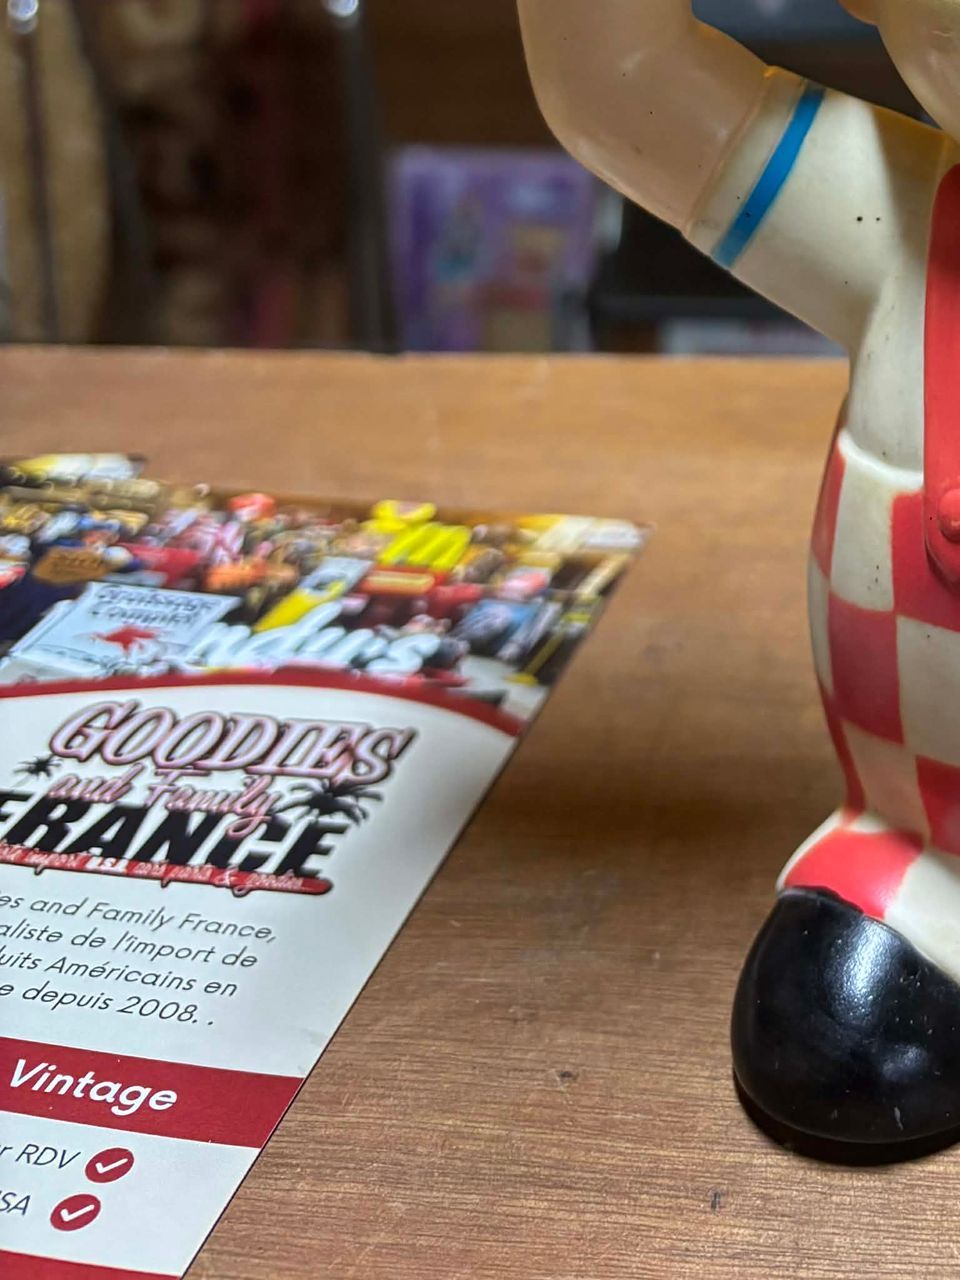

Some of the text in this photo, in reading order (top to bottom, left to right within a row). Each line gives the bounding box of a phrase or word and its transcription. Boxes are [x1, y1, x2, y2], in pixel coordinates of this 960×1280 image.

[50, 699, 417, 786] GOODIES
[48, 763, 283, 841] and Family
[30, 897, 89, 916] and
[87, 902, 175, 931] Family
[178, 913, 277, 944] France,
[70, 927, 106, 949] de
[112, 931, 216, 963] l'import
[221, 945, 258, 969] de
[22, 981, 113, 1011] depuis
[44, 956, 197, 992] Américains
[203, 980, 238, 998] en
[9, 1058, 177, 1116] Vintage
[15, 1143, 81, 1169] RDV
[0, 1190, 31, 1216] SA
